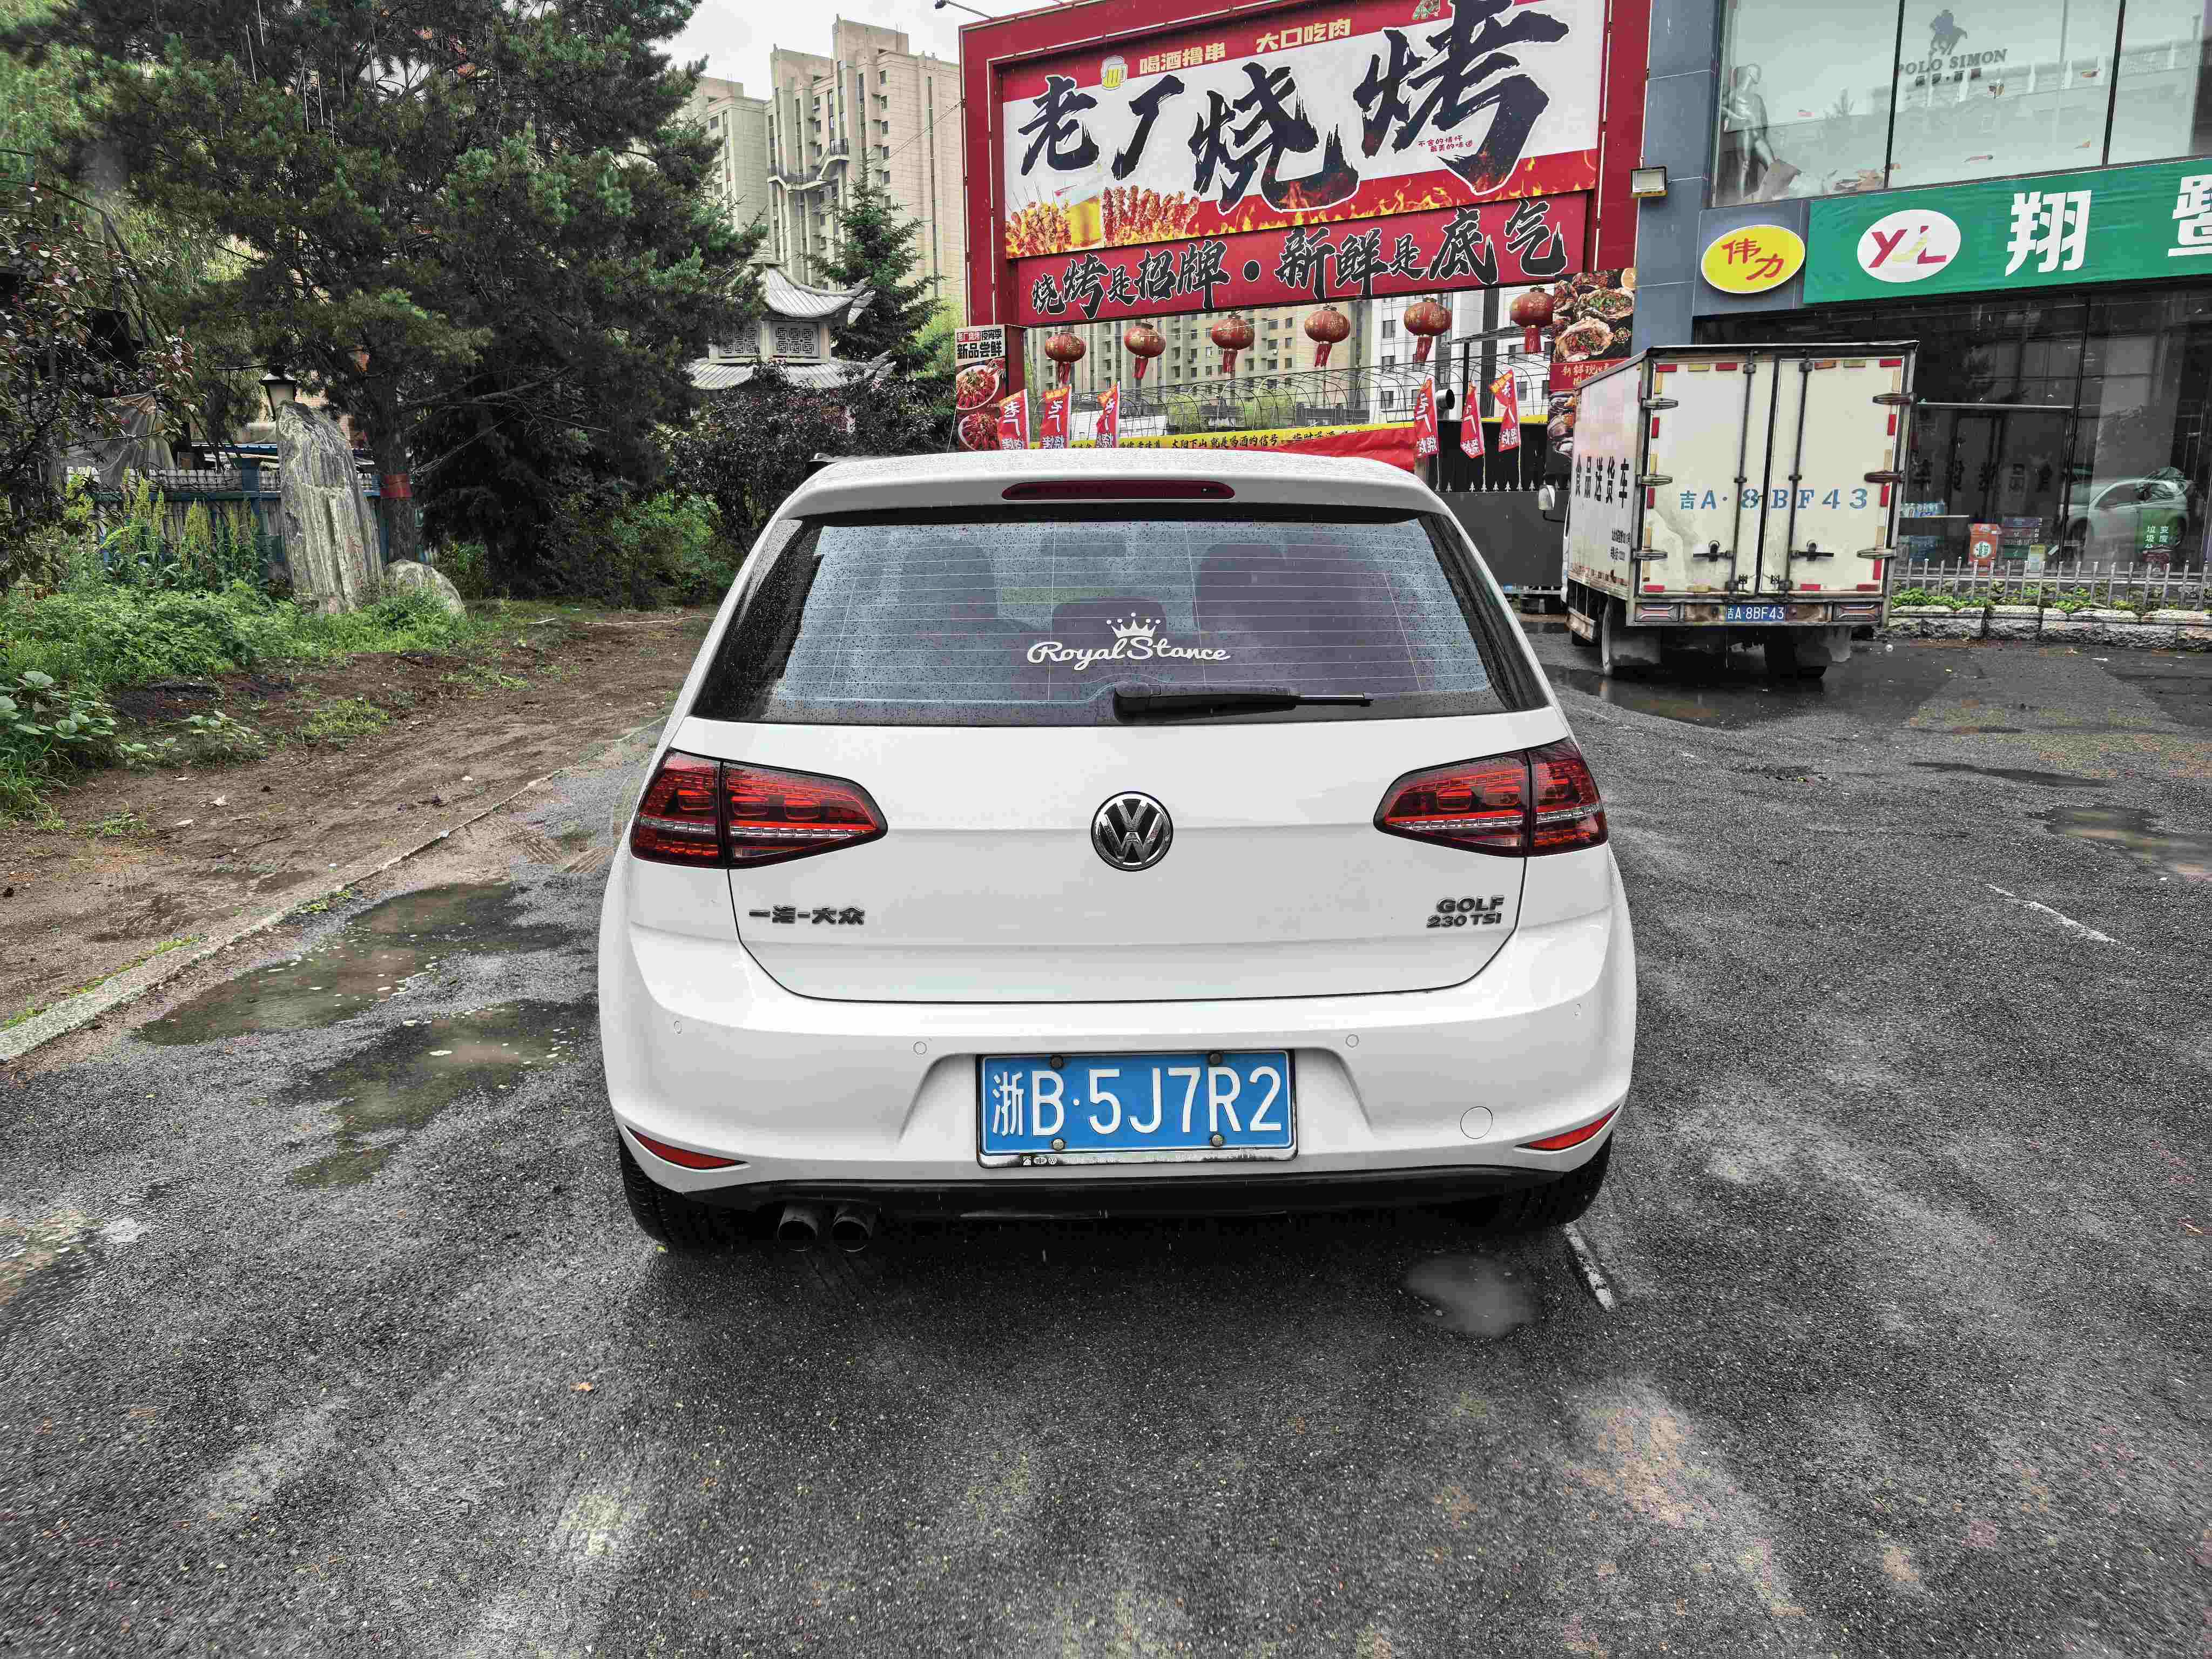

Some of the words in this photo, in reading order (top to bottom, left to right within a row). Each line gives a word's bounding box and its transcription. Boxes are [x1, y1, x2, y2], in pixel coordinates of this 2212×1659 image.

[1139, 42, 1226, 75] 喝酒撸串
[1256, 18, 1351, 52] 大口吃肉
[1949, 49, 2007, 69] SIMON
[1017, 0, 1570, 213] 老厂烧烤
[1721, 238, 1784, 281] 伟力
[957, 341, 1002, 359] 新品尝鲜
[1727, 606, 1785, 620] 吉A·8BF43
[1437, 896, 1505, 914] GOLF
[992, 1065, 1282, 1137] 浙B·5J7R2
